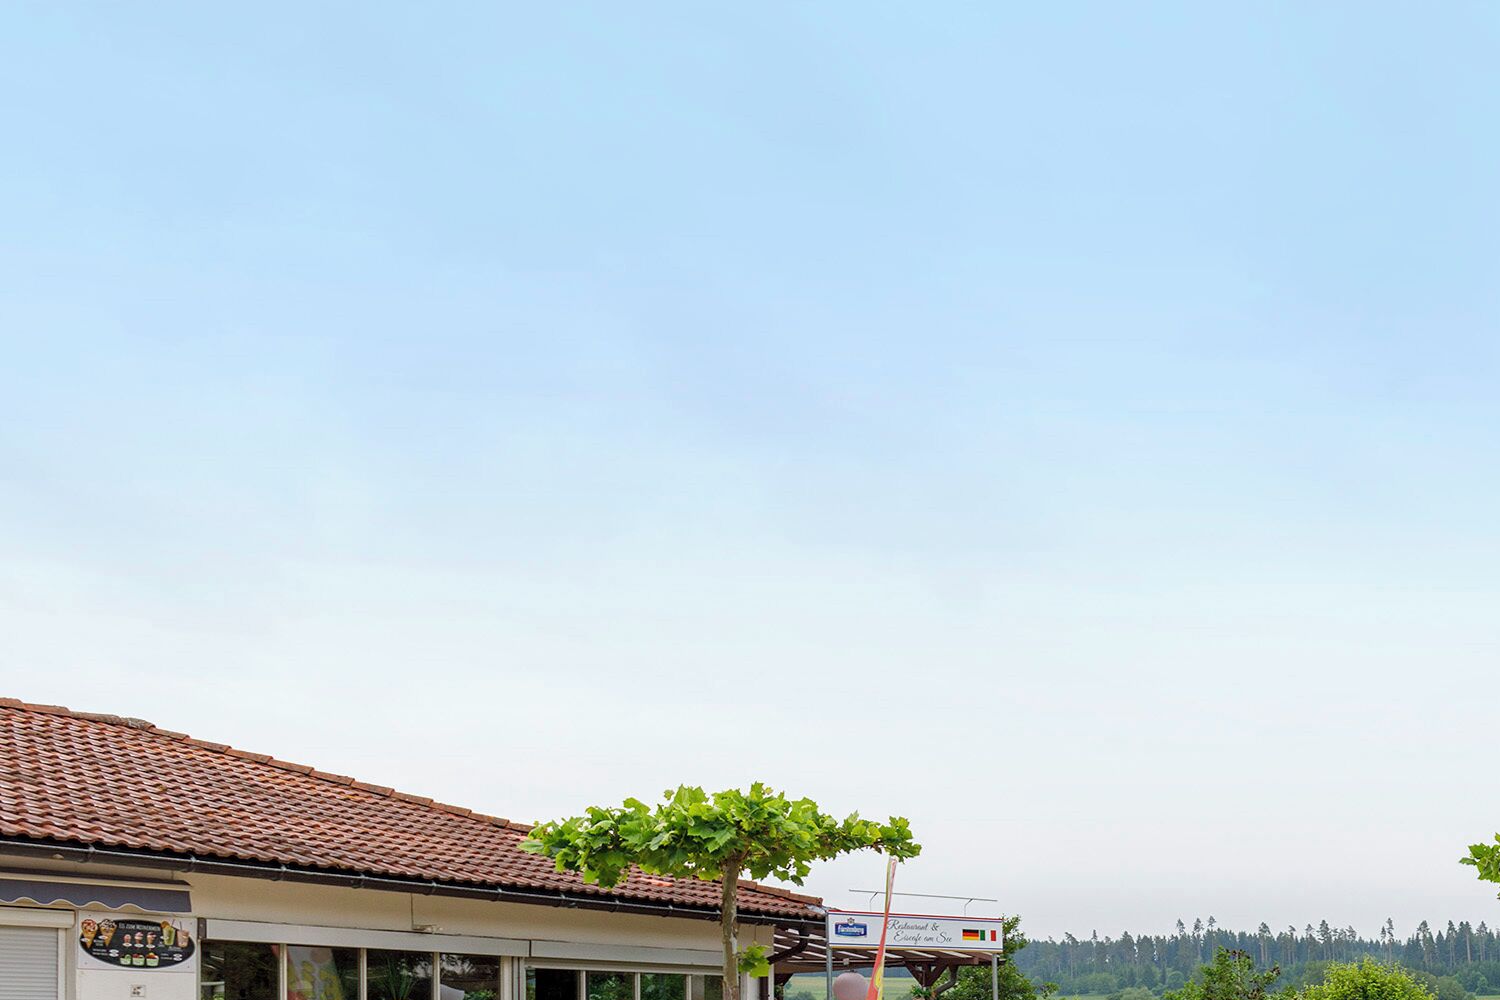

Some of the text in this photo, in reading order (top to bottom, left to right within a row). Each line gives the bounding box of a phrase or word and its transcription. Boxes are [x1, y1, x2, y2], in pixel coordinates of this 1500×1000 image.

[887, 919, 940, 931] Restaurant &
[936, 931, 952, 943] See
